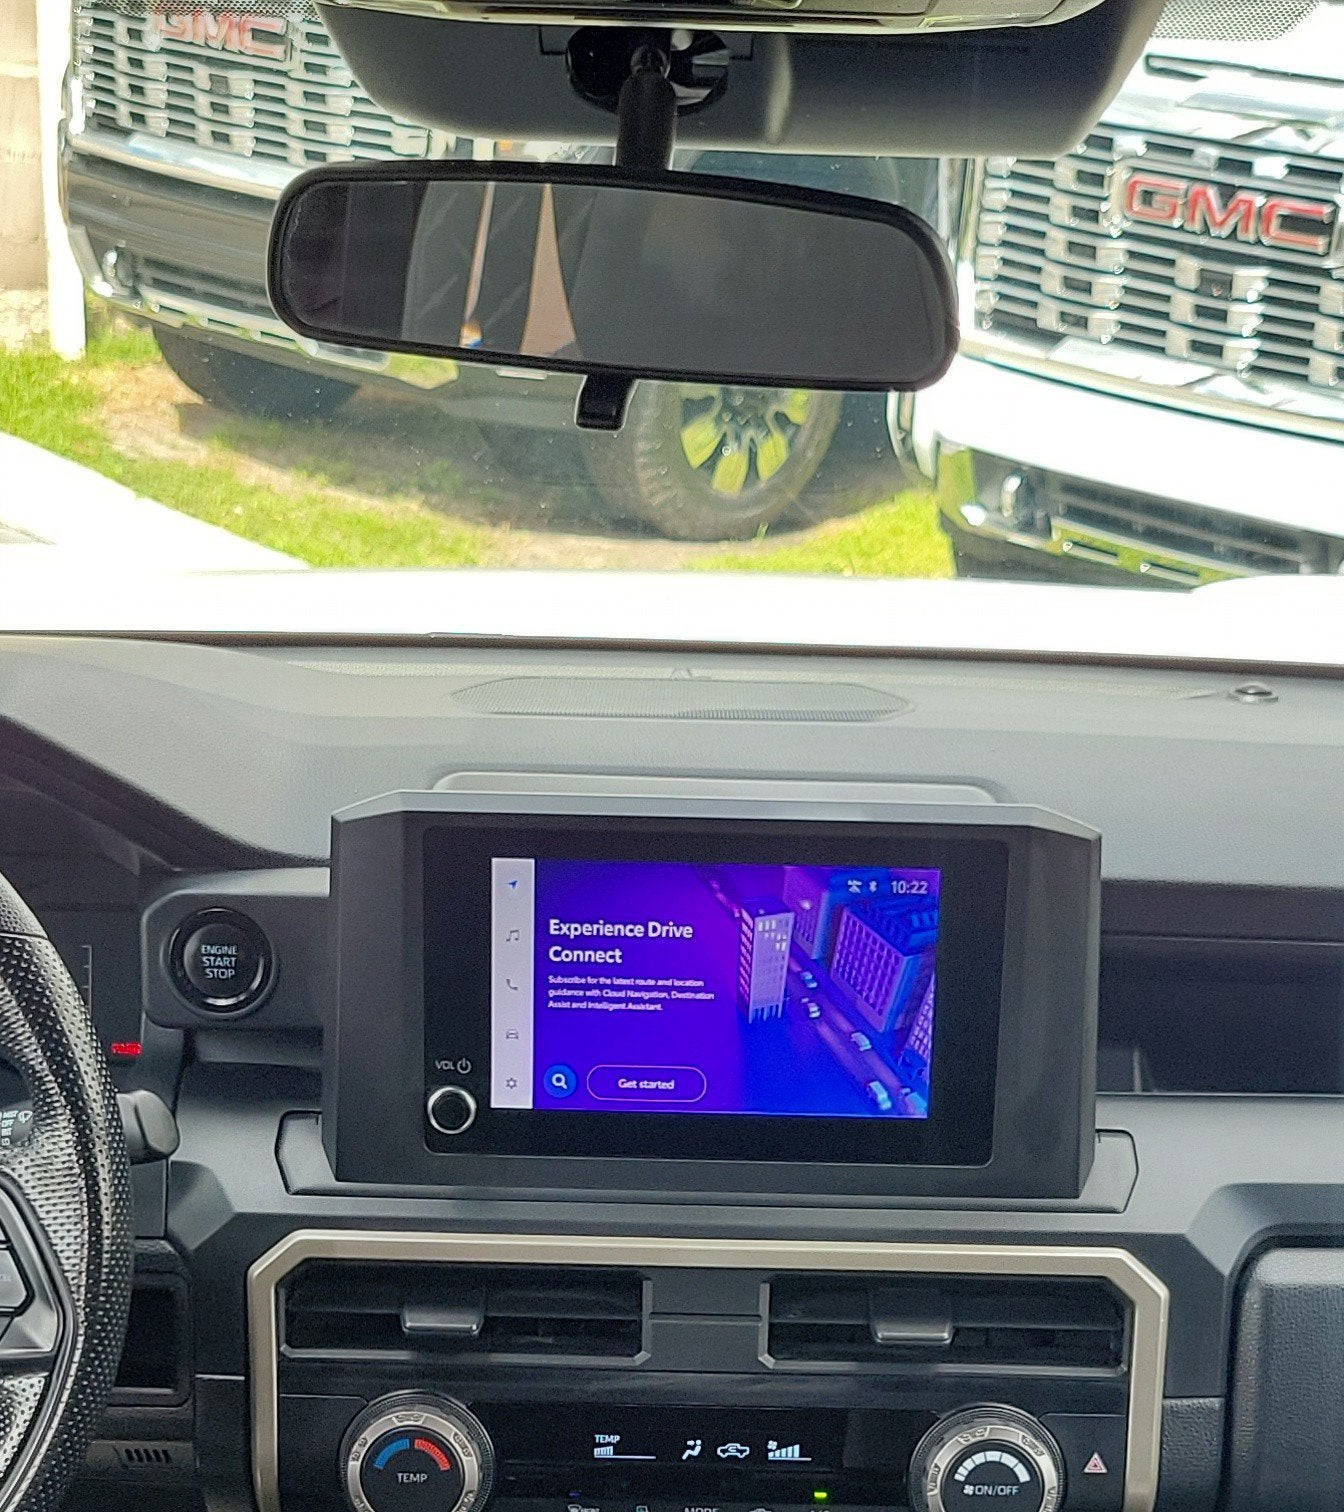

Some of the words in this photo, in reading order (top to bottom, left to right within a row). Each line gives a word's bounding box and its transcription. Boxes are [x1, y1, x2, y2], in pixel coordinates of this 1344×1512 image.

[1124, 174, 1335, 255] GMC
[891, 880, 929, 895] 10:22
[548, 918, 645, 939] Experience
[647, 920, 693, 939] Drive
[201, 944, 238, 955] ENGINE
[548, 945, 623, 964] Connect
[202, 956, 237, 967] START
[205, 968, 236, 979] STOP
[548, 975, 586, 985] Subscribe
[587, 976, 598, 985] for
[599, 976, 611, 985] the
[612, 977, 635, 986] latest
[635, 978, 656, 986] route
[657, 978, 672, 986] and
[673, 978, 704, 987] location
[548, 988, 584, 998] guidance
[585, 989, 601, 997] with
[602, 989, 626, 998] Cloud
[627, 990, 670, 1000] Navigation,
[671, 990, 714, 1000] Destination
[548, 1000, 570, 1009] Assist
[571, 1001, 587, 1009] and
[587, 1001, 626, 1011] Intelligent
[434, 1059, 455, 1070] VOL
[617, 1078, 638, 1089] Get
[638, 1079, 675, 1090] started
[594, 1434, 621, 1444] TEMP
[396, 1472, 428, 1483] TEMP
[974, 1485, 1020, 1497] ON/OFF
